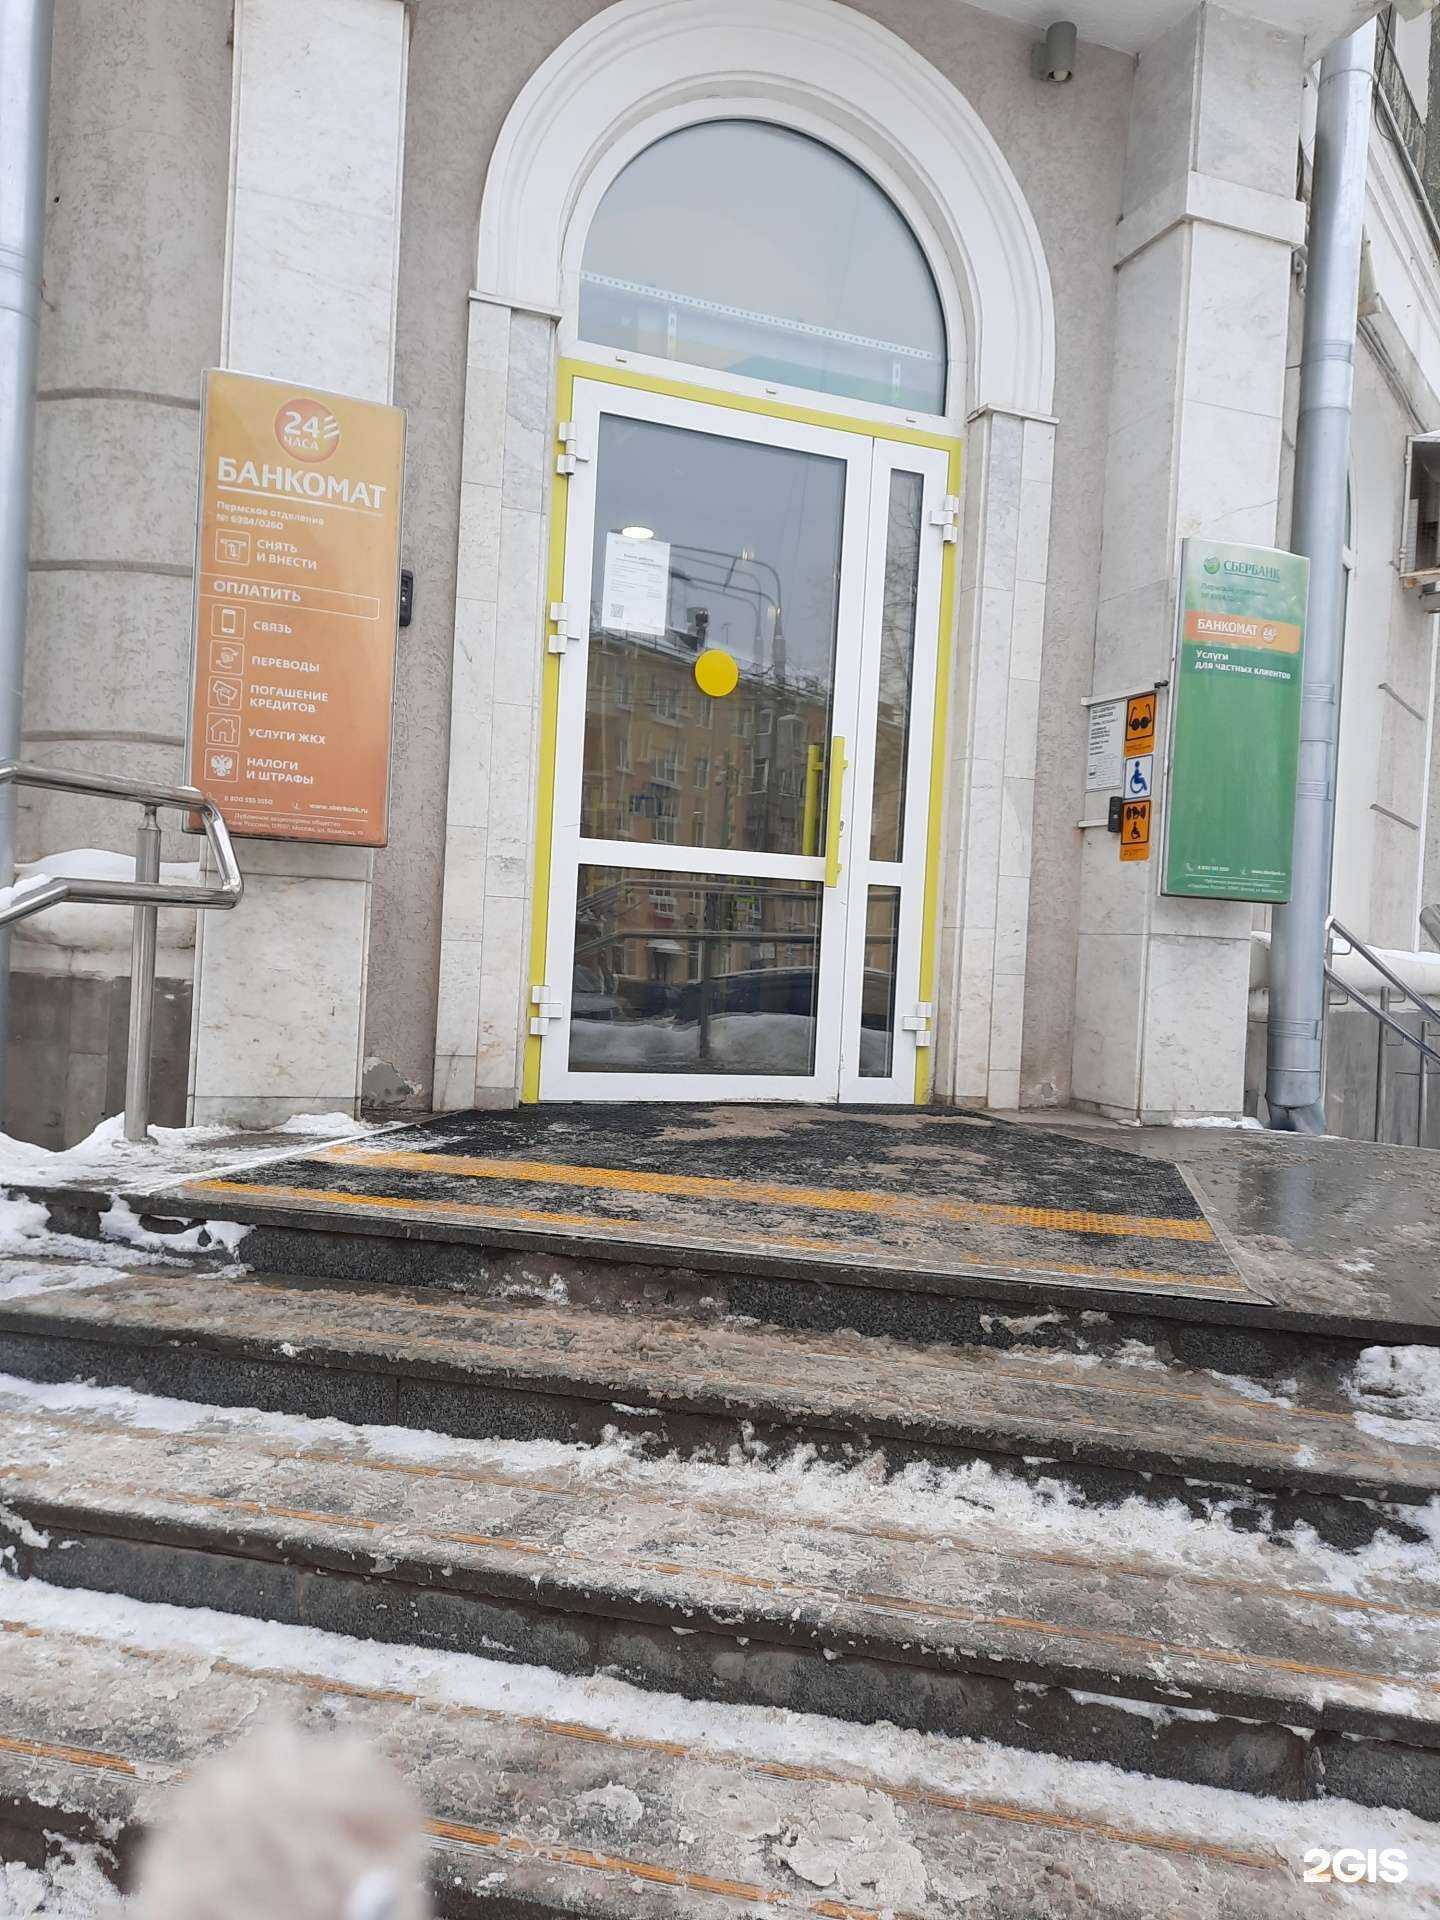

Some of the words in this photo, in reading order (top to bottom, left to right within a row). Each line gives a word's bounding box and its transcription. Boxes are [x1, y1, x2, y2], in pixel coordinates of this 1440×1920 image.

[284, 411, 320, 439] 24
[284, 435, 320, 451] ЧАСА
[217, 455, 387, 510] БАНКОМАТ
[256, 539, 299, 554] СНЯТЬ
[256, 553, 266, 563] И
[268, 553, 318, 570] ВНЕСТИ
[1223, 560, 1281, 580] СБЕРБАНК
[213, 580, 302, 602] ОПЛАТИТЬ
[253, 620, 293, 634] СВЯЗЬ
[1197, 618, 1258, 636] БАНКОМАТ
[1195, 649, 1229, 660] Услуги
[251, 656, 321, 673] ПЕРЕВОДЫ
[1195, 661, 1213, 670] для
[1215, 663, 1253, 674] частных
[1254, 667, 1291, 680] клиентов
[250, 684, 329, 702] ПОГАШЕНИЕ
[250, 698, 316, 713] КРЕДИТОВ
[248, 728, 296, 742] УСЛУГИ
[298, 732, 327, 745] ЖКХ
[247, 757, 299, 770] НАЛОГИ
[246, 771, 256, 779] И
[258, 771, 315, 785] ШТРАФЫ
